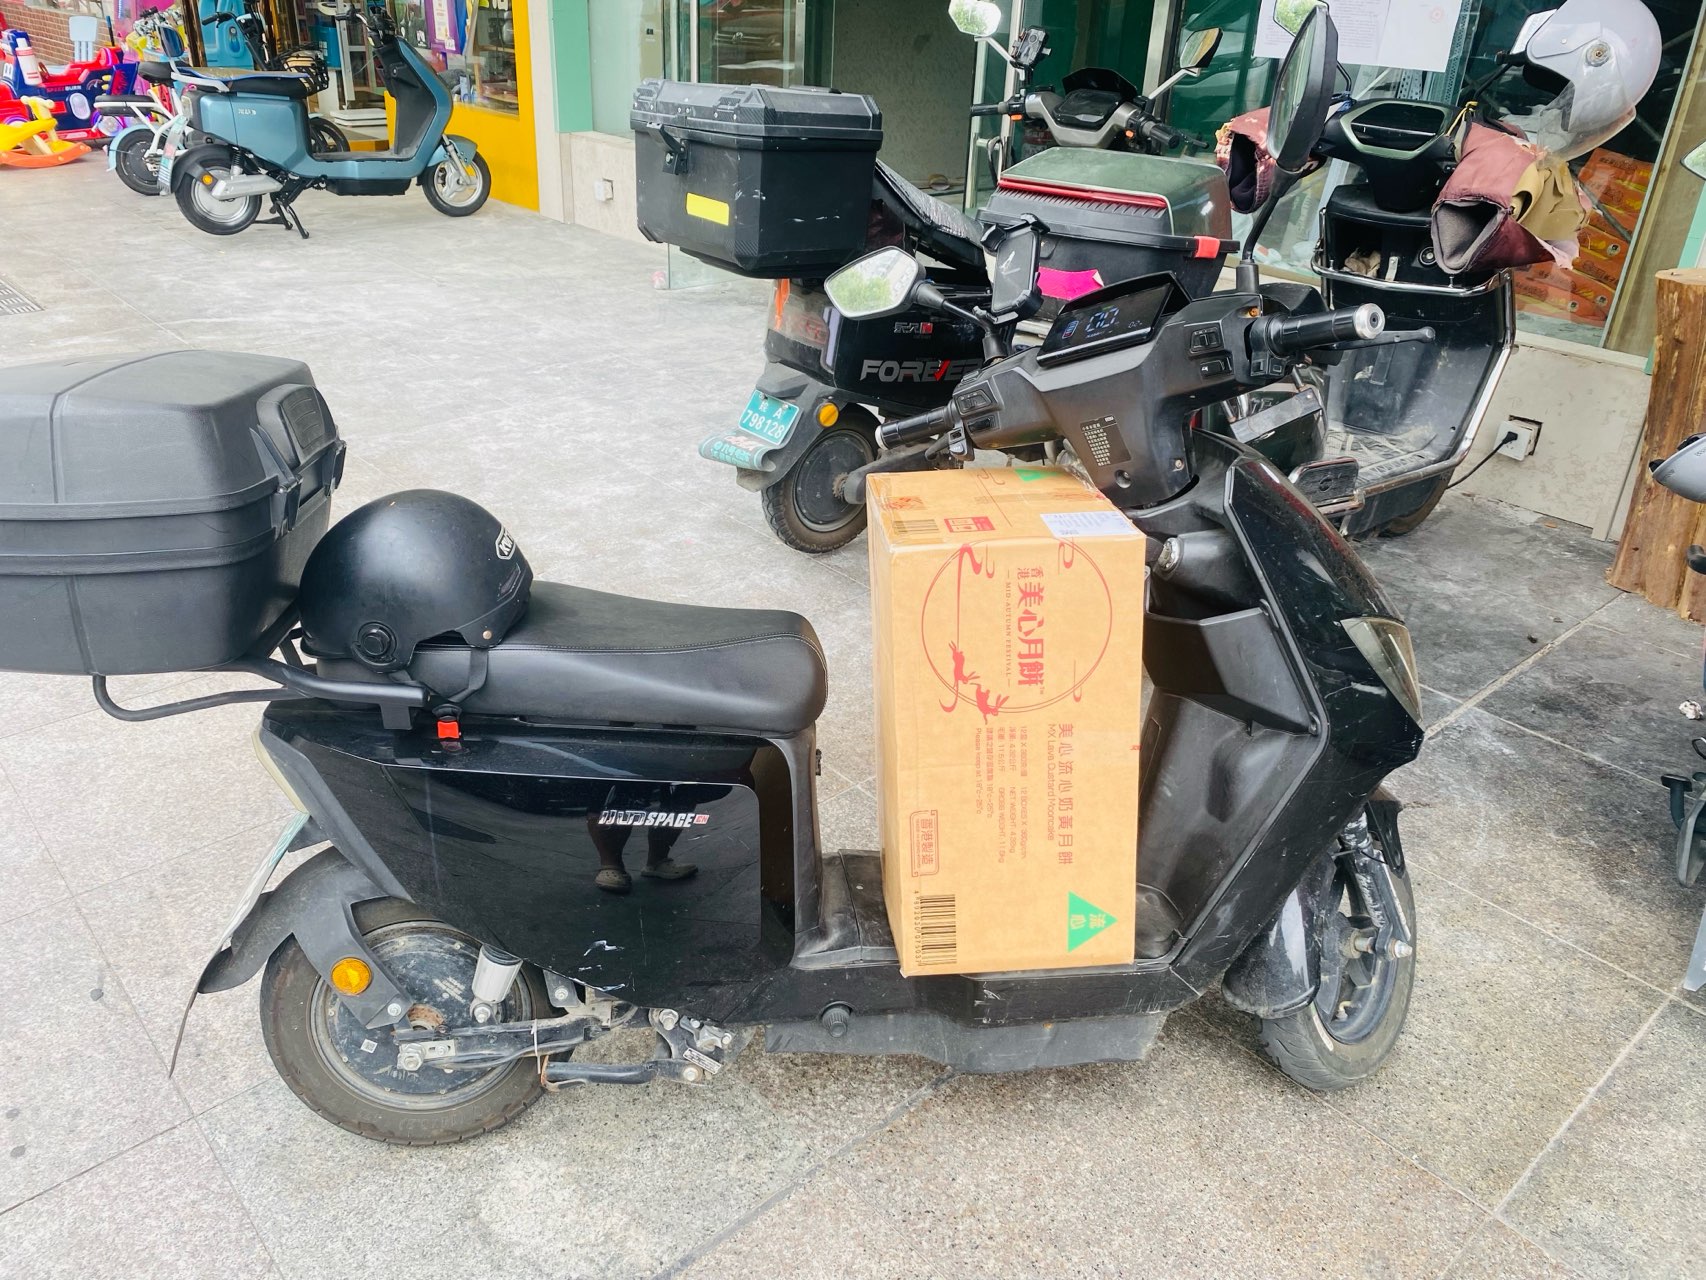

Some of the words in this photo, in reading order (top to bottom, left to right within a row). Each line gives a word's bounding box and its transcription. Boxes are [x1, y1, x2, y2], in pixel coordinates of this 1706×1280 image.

[742, 409, 785, 439] 798128
[772, 407, 783, 419] A
[1017, 566, 1044, 580] 香港
[1017, 582, 1045, 686] 美心月餅
[1047, 723, 1056, 738] MX
[1047, 740, 1056, 761] Lava
[1047, 763, 1056, 797] Custard
[1047, 798, 1056, 841] Mooncake
[921, 818, 934, 865] 香港製造
[1070, 913, 1106, 930] 流心
